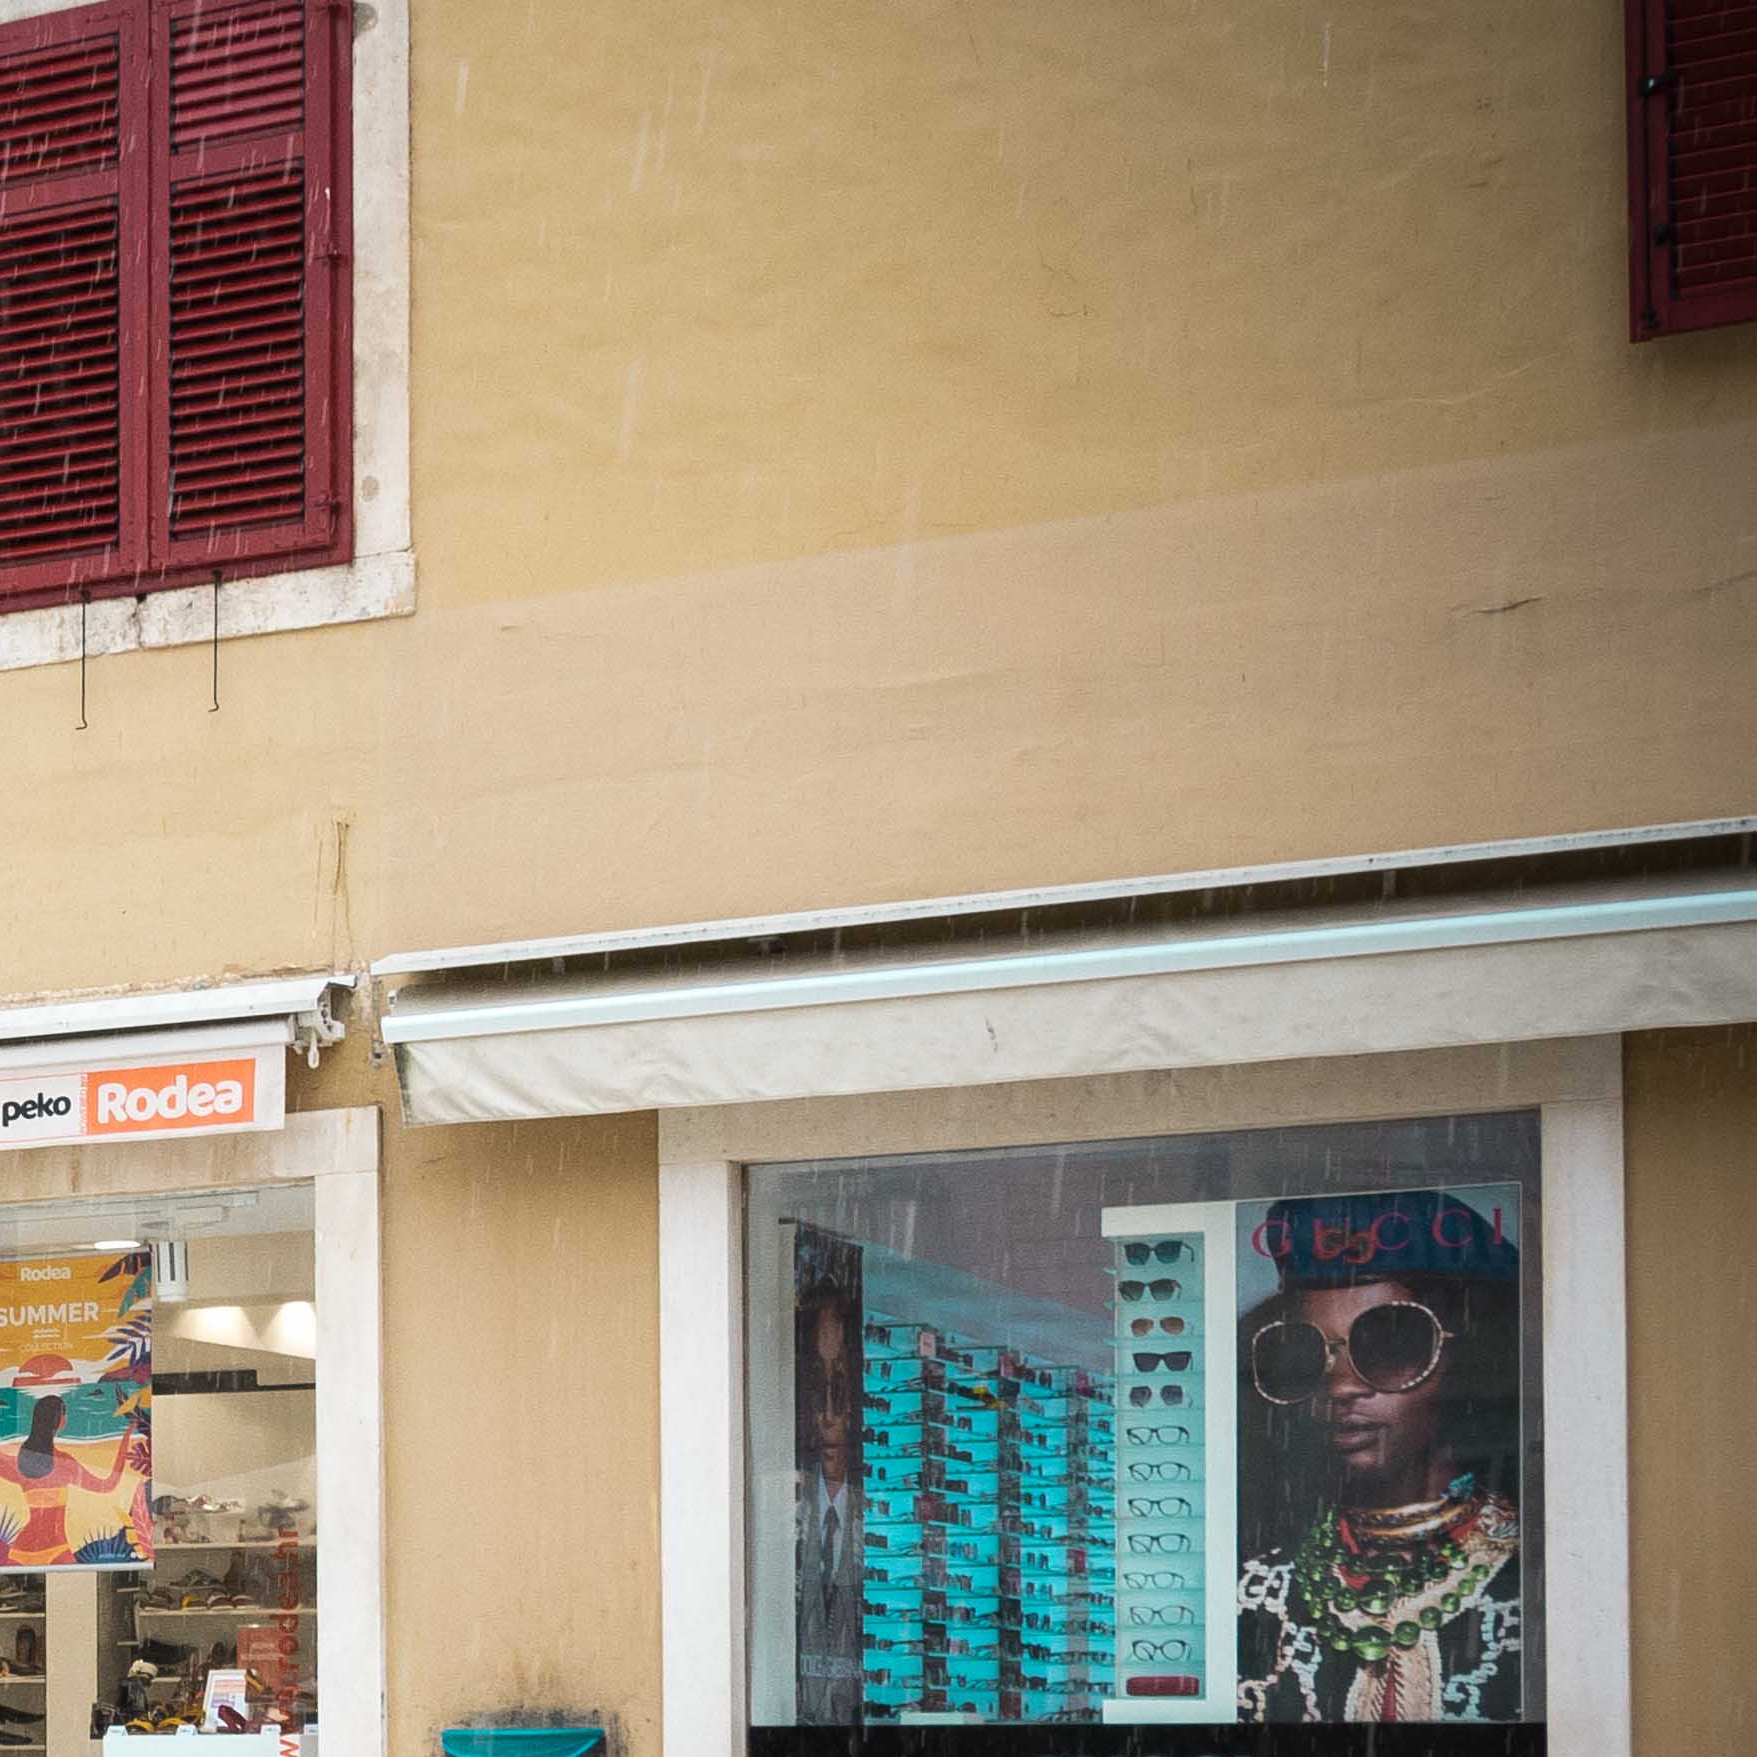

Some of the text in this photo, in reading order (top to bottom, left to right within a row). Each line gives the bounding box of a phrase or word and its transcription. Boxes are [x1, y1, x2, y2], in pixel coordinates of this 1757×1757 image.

[2, 1092, 73, 1127] peko
[97, 1074, 245, 1123] Rodea
[1252, 1206, 1503, 1259] GUCCI
[21, 1265, 72, 1282] Rodea
